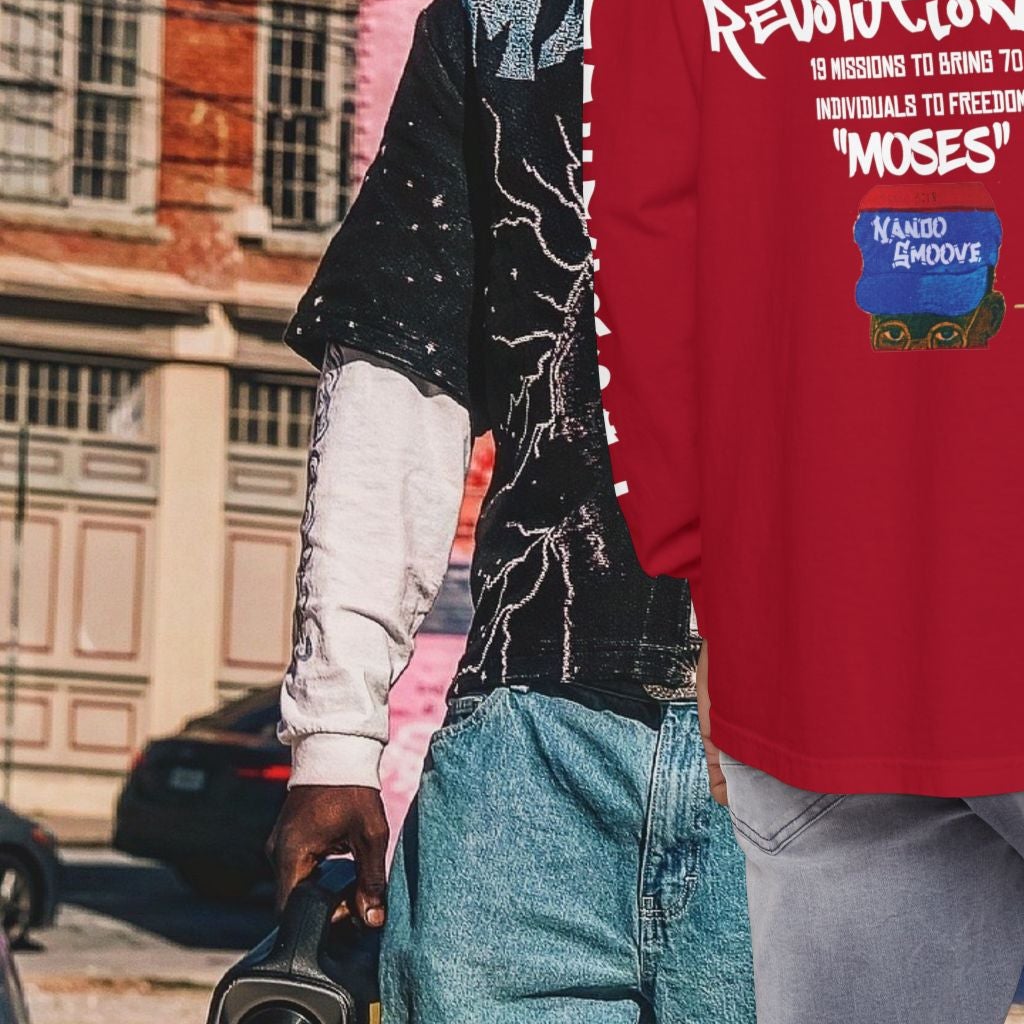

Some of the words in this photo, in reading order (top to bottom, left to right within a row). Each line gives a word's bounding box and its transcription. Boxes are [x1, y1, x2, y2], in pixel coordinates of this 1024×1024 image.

[810, 57, 827, 80] 19
[831, 55, 906, 80] MISSIONS
[911, 53, 934, 76] TO
[939, 50, 993, 75] BRING
[998, 49, 1023, 72] 70
[816, 94, 917, 120] INDIVIDUALS
[921, 93, 944, 116] TO
[833, 121, 1010, 178] "MOSES"
